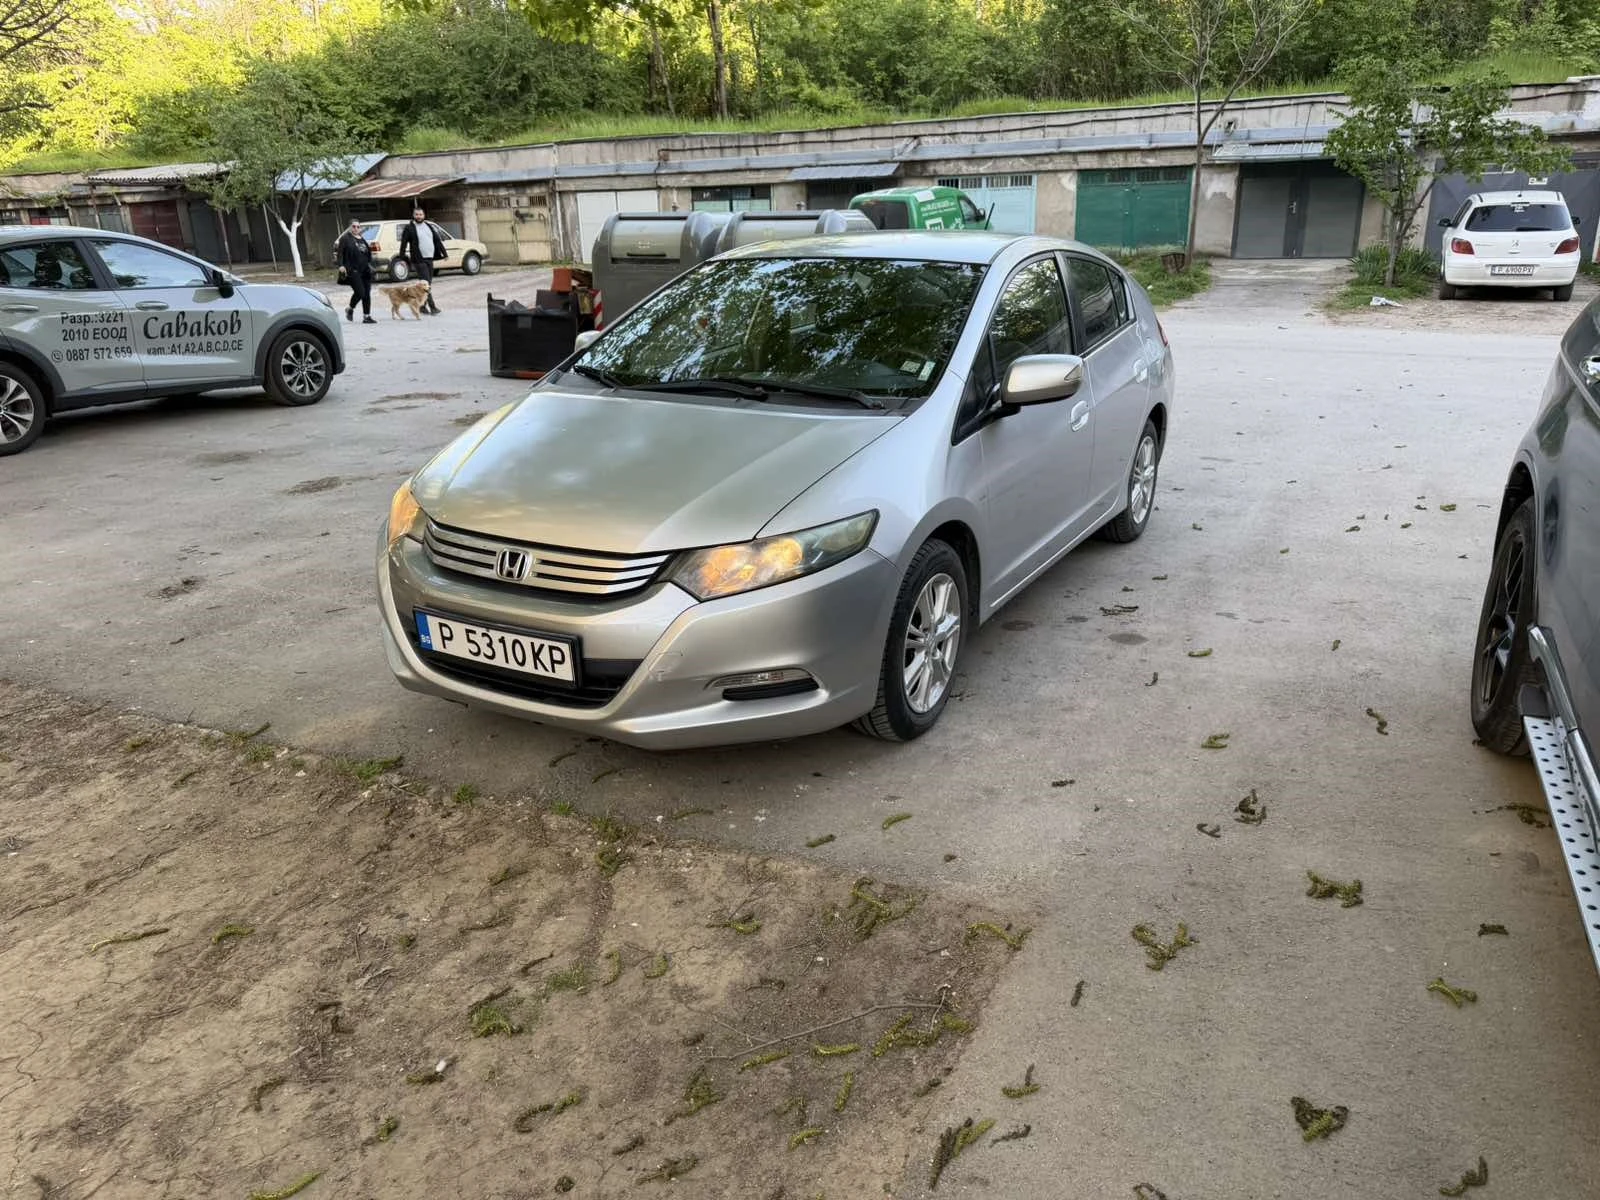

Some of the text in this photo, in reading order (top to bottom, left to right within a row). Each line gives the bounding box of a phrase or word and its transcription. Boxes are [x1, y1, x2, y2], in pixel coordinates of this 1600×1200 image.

[62, 326, 128, 342] 2010 ЕООД
[66, 345, 133, 362] 0887 572 659
[438, 621, 454, 649] P
